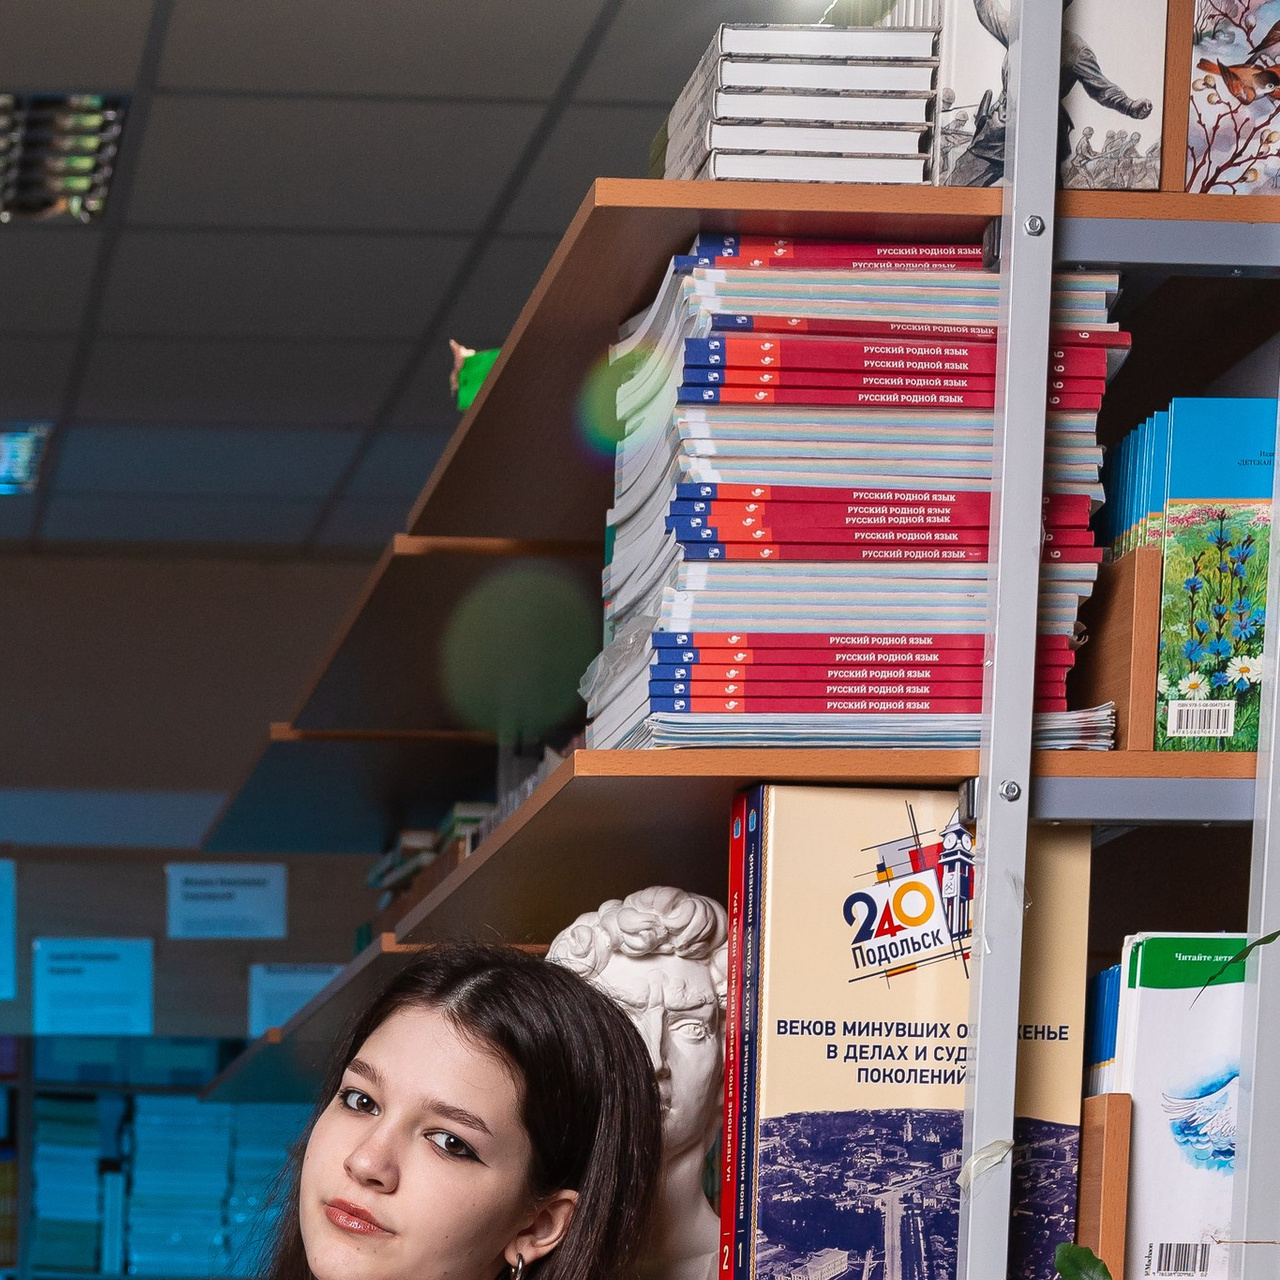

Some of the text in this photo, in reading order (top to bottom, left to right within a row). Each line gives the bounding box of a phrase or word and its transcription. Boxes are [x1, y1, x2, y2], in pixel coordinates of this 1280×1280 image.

[877, 247, 917, 255] РУССКИЙ
[919, 247, 955, 256] РОДНОЙ
[1079, 331, 1090, 339] 6
[863, 345, 968, 356] РУССКИЙ РОДНОЙ ЯЗЫК
[858, 393, 963, 403] РУССКИЙ РОДНОЙ ЯЗЫК
[853, 491, 956, 501] РУССКИЙ РОДНОЙ ЯЗЫК
[854, 531, 895, 540] РУССКИЙ
[897, 532, 932, 541] РОДНОЙ
[1050, 550, 1061, 559] 6
[829, 635, 933, 645] РУССКИЙ РОДНОЙ ЯЗЫК
[827, 700, 930, 710] РУССКИЙ РОДНОЙ ЯЗЫК
[843, 881, 935, 944] 240
[851, 928, 944, 969] Подольск
[1175, 952, 1212, 962] Читайте
[776, 1019, 1069, 1041] ВЕКОВ МИНУВШИХ ОЕНЬЕ
[826, 1044, 838, 1060] В
[843, 1045, 908, 1062] ДЕЛАХ
[915, 1047, 927, 1061] И
[857, 1066, 967, 1084] ПОКОЛЕНИЙ
[726, 1166, 731, 1182] НА
[722, 1244, 729, 1270] 2
[738, 1242, 743, 1268] 1
